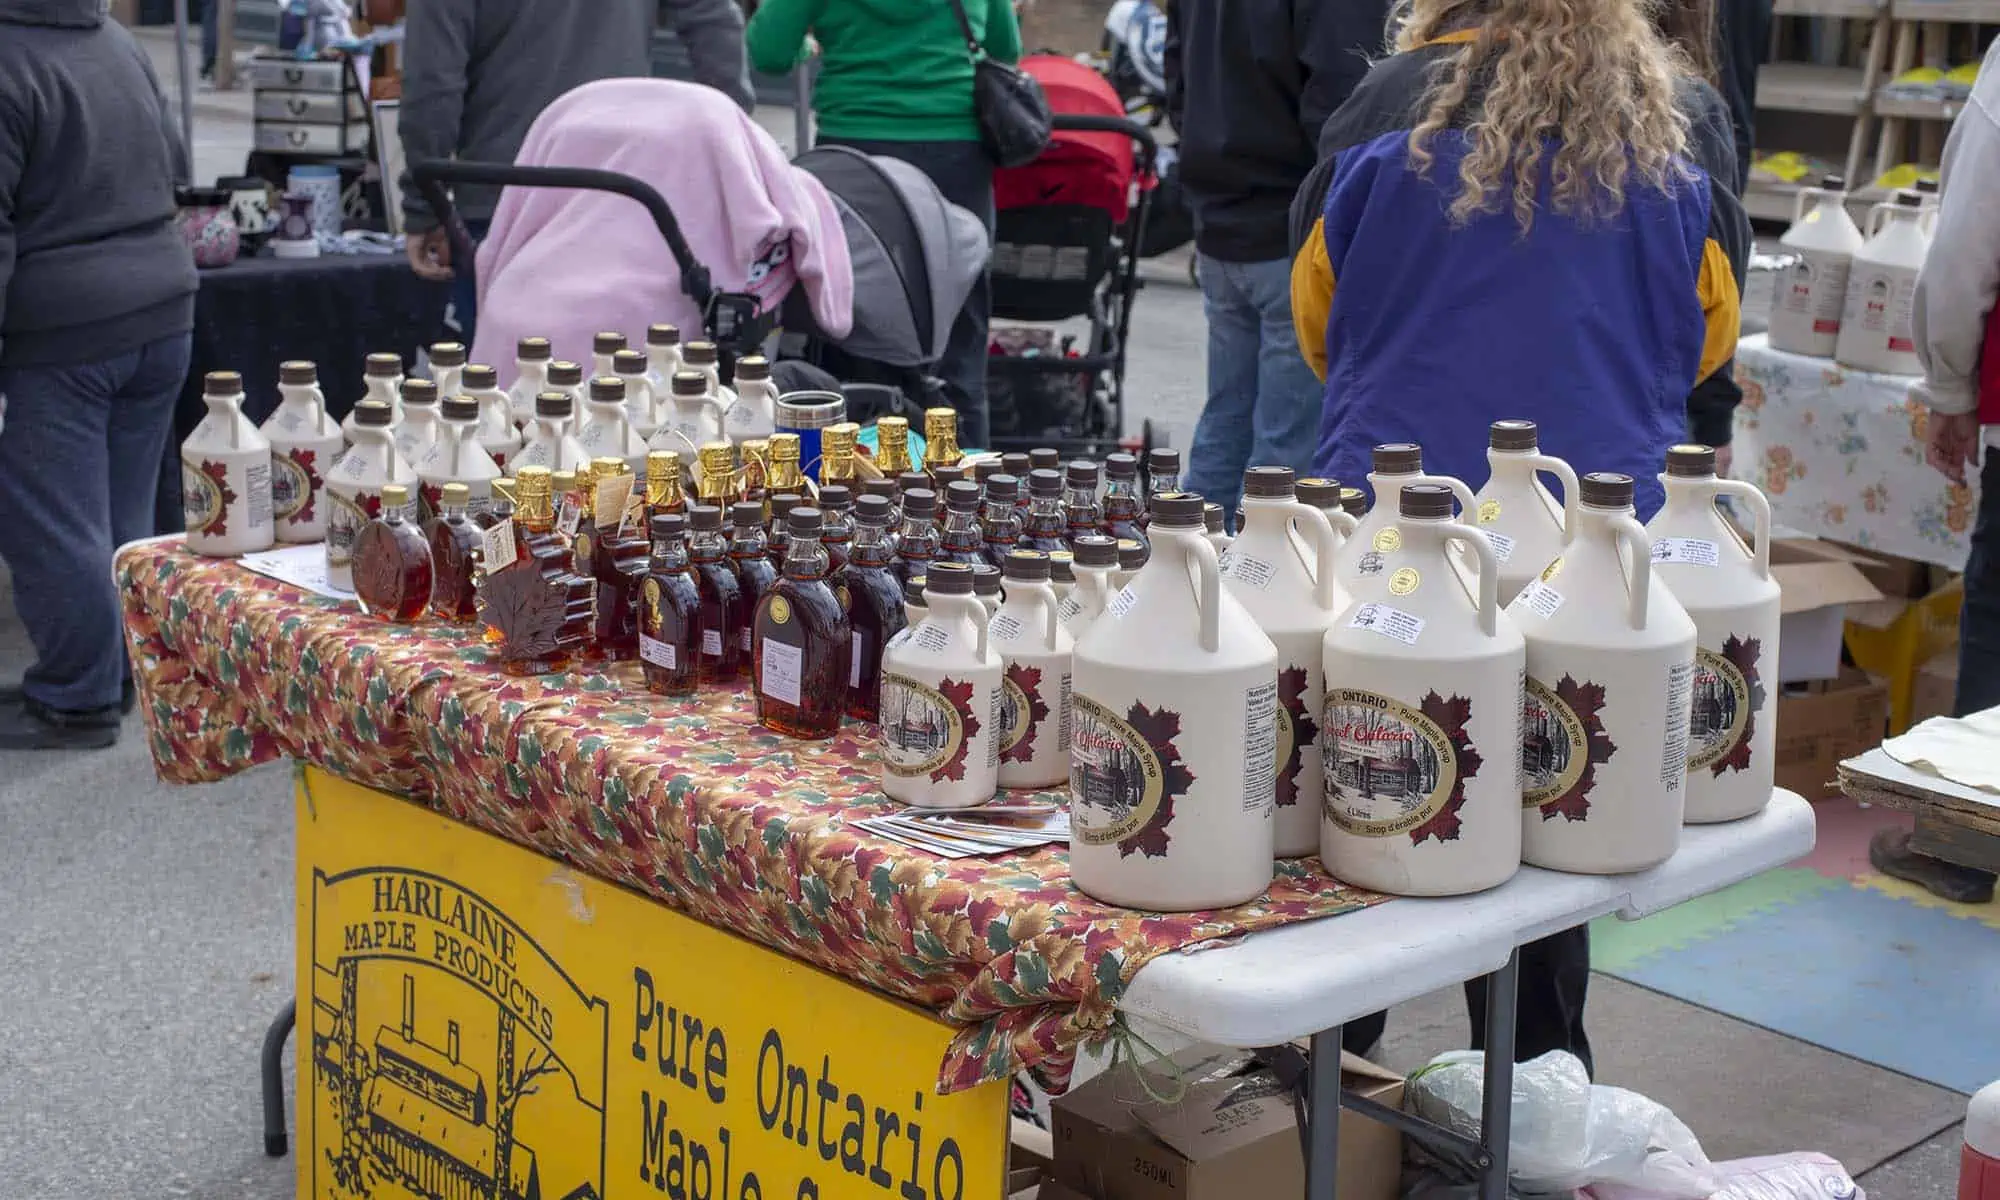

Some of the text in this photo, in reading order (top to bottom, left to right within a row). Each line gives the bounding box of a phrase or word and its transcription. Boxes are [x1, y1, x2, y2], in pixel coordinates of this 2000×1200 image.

[1703, 653, 1721, 667] Pure
[1341, 690, 1388, 710] ONTARIO
[1399, 707, 1421, 725] Pure
[1420, 718, 1440, 741] Maple
[1436, 738, 1450, 764] Syrup
[1354, 722, 1415, 743] Ontario
[1536, 687, 1555, 705] Pure
[1569, 720, 1582, 747] Syrup
[1109, 717, 1126, 734] Pure
[1125, 731, 1146, 758] Maple
[1143, 753, 1157, 779] Syrup
[1126, 817, 1140, 833] pur
[1365, 804, 1433, 835] Sirop d'érable pur
[373, 876, 516, 973] HARLAINE
[345, 921, 553, 1042] MAPLE PRODUCTS
[632, 966, 964, 1200] Pure Ontario
[1134, 1157, 1176, 1189] 250ML
